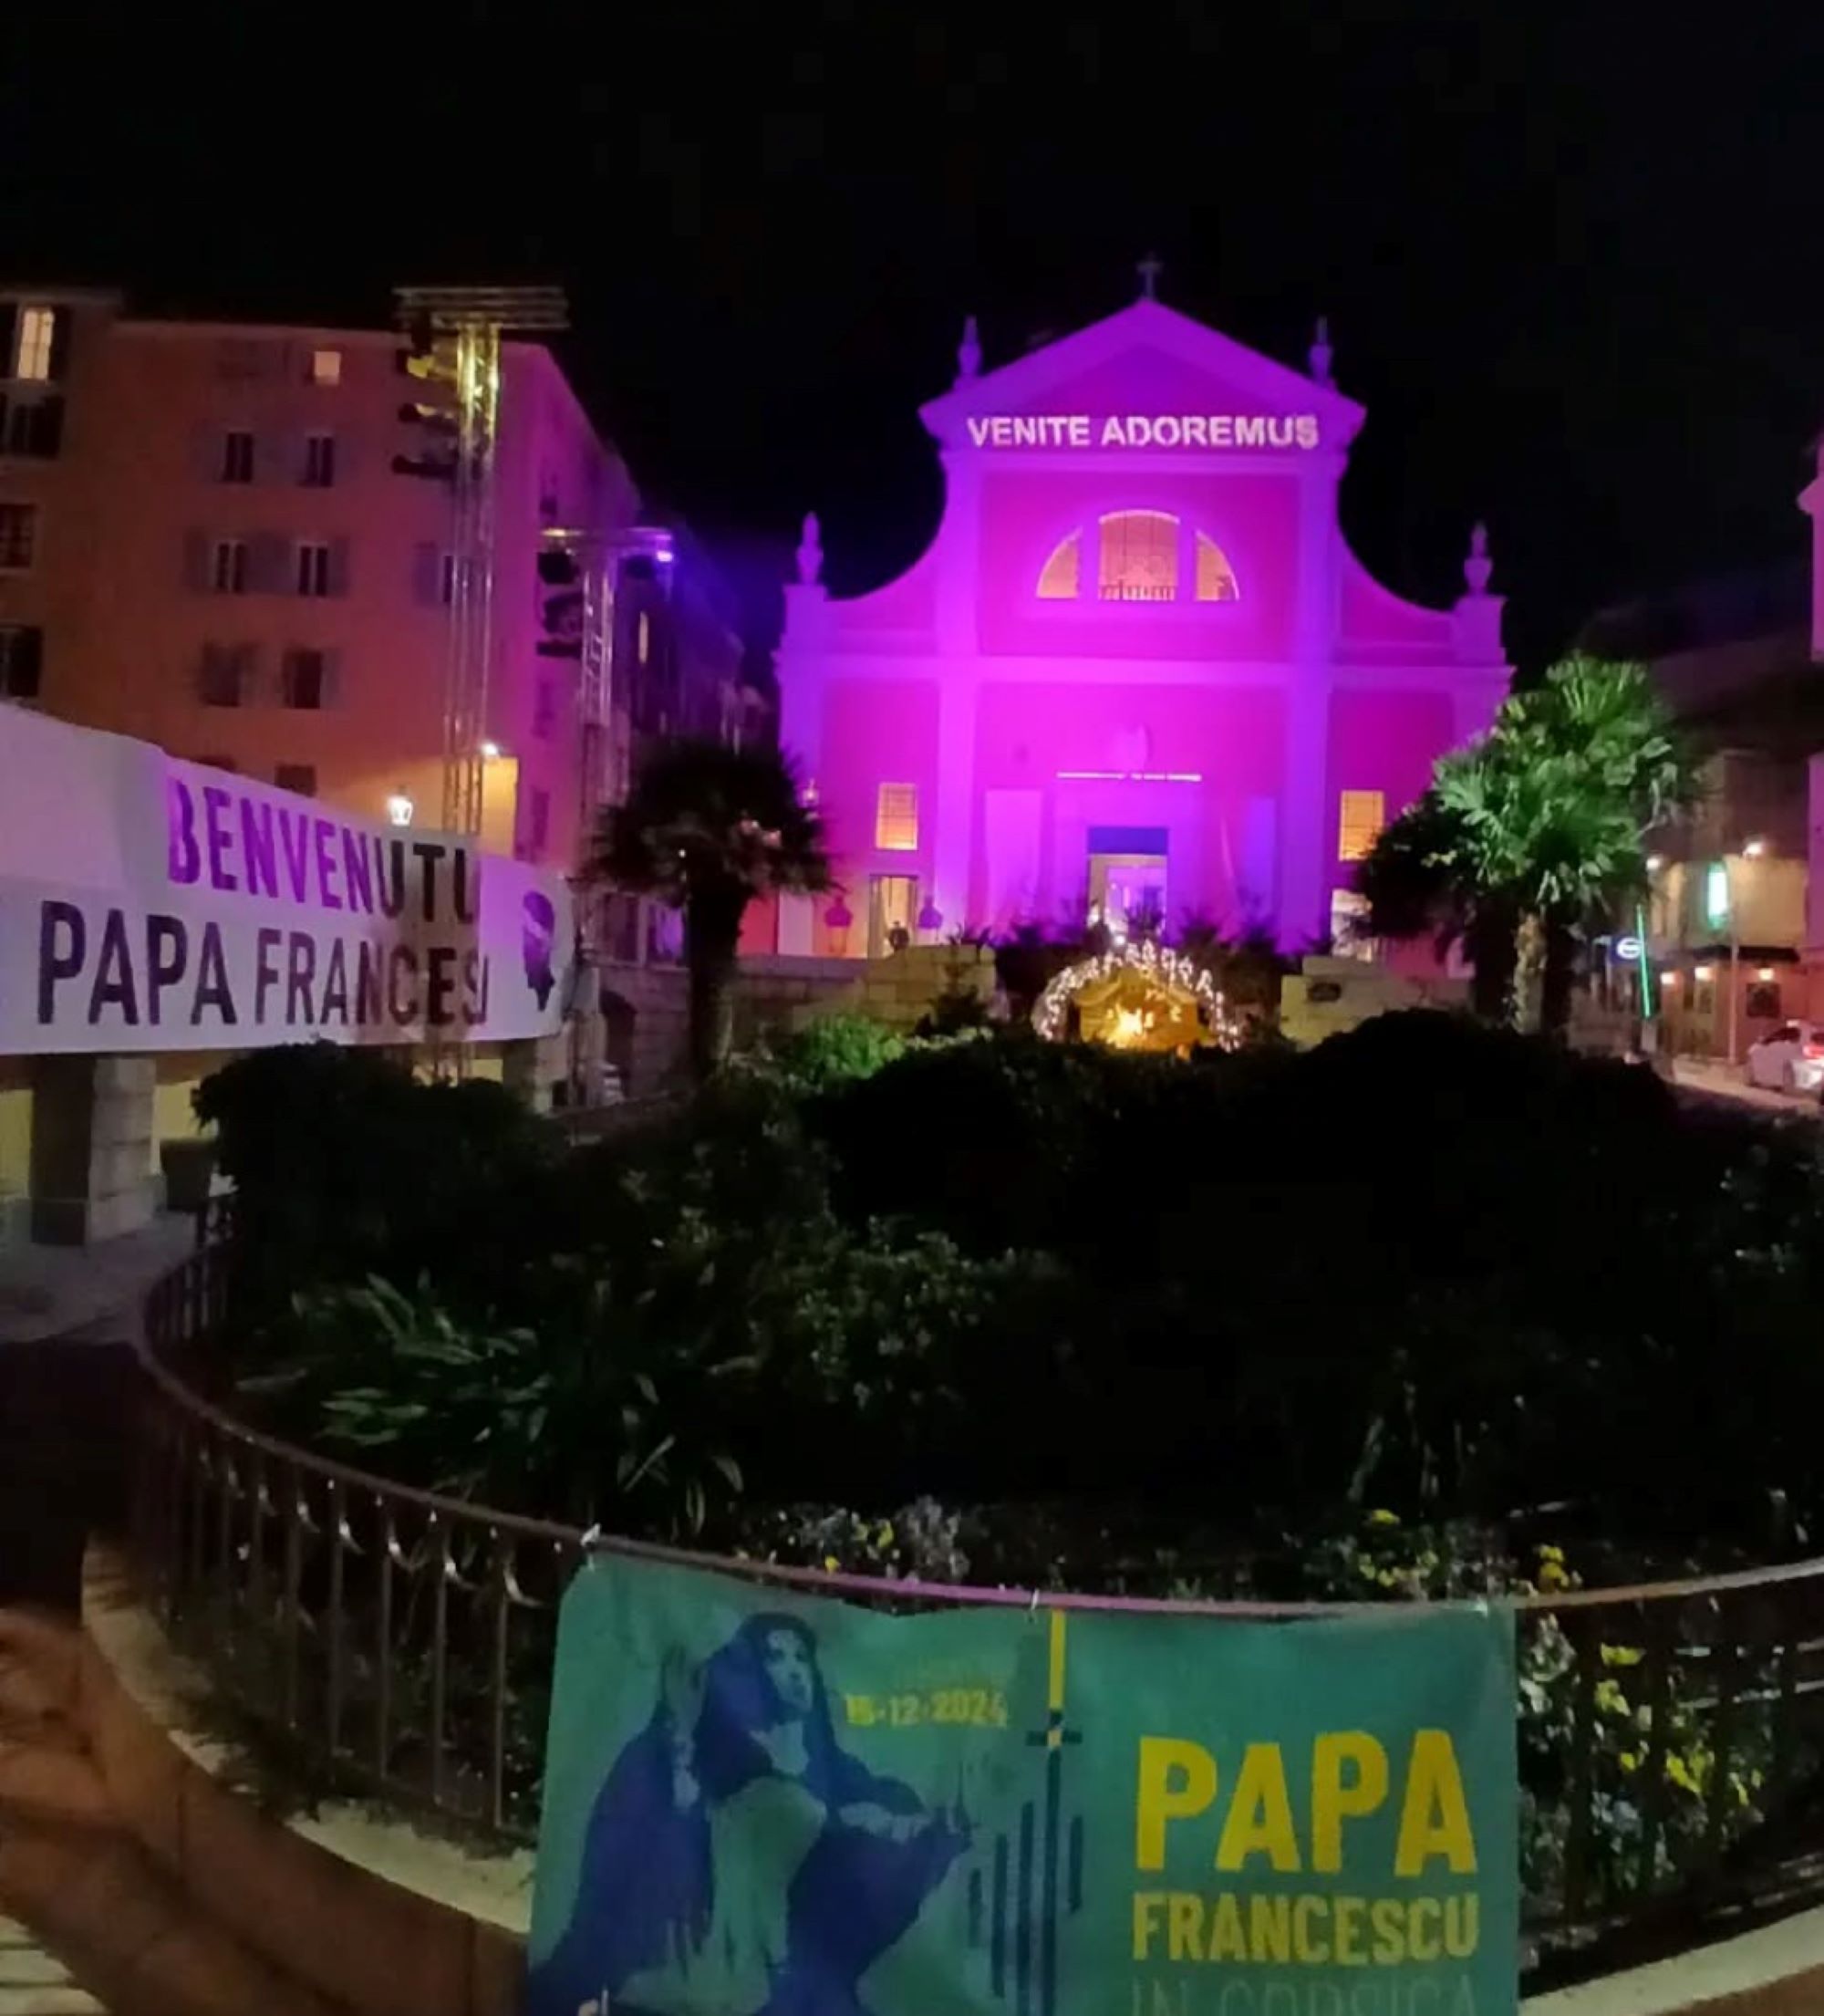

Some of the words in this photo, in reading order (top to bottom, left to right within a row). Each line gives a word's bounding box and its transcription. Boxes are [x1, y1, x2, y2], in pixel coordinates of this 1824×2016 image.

[967, 415, 1092, 447] VENITE
[1101, 414, 1320, 449] ADOREMUS
[37, 899, 237, 1026] PAPA
[1135, 1728, 1478, 1877] PAPA
[1132, 1891, 1480, 1966] FRANCESCU
